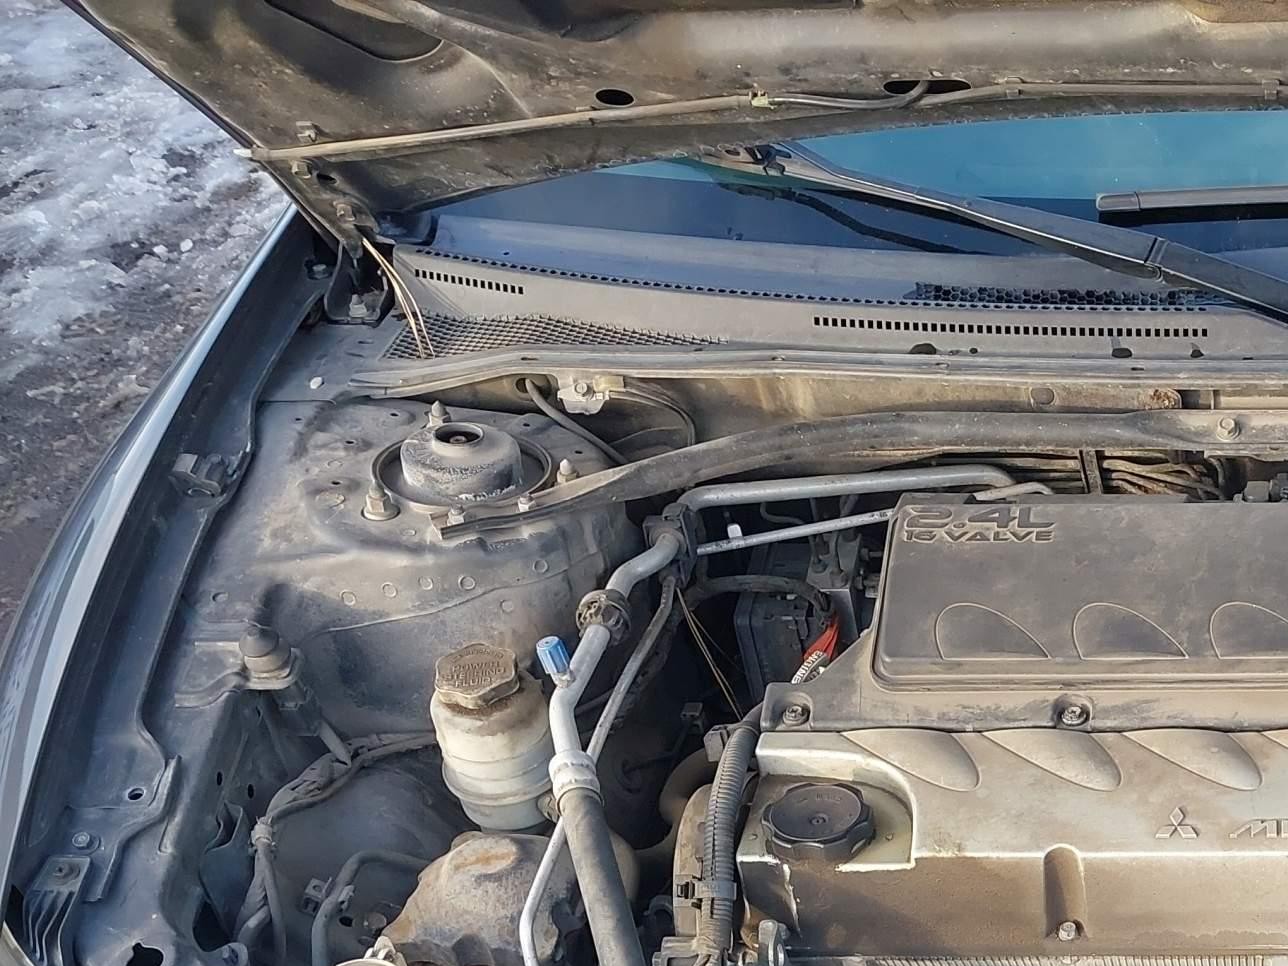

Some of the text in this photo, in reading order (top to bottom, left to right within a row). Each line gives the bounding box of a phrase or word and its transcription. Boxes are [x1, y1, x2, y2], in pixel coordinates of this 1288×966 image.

[905, 504, 1055, 529] 2.4L
[904, 530, 1053, 541] 16 VALVE
[452, 661, 500, 672] POWER
[442, 667, 505, 680] STEERING
[455, 676, 493, 688] FLUID
